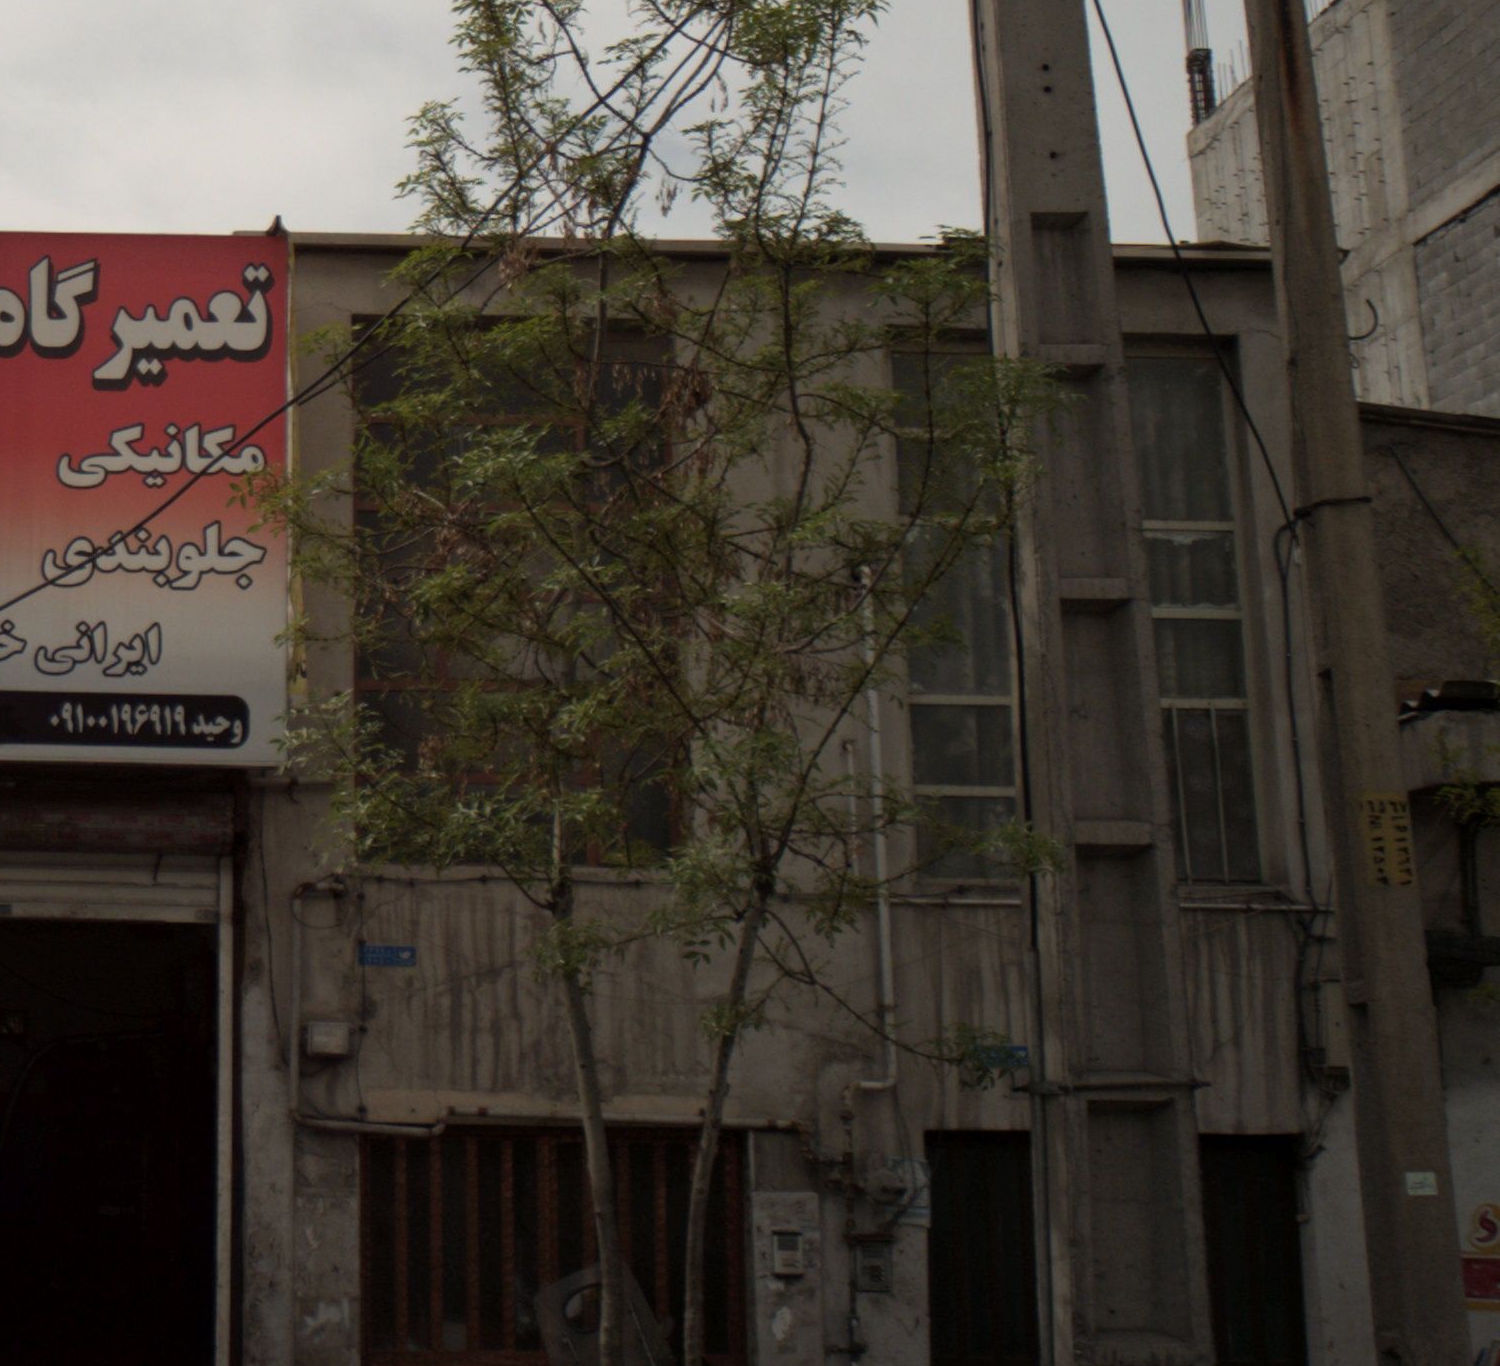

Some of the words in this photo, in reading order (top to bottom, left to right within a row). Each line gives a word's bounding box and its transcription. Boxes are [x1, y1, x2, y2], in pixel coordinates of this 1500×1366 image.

[57, 424, 267, 487] مکانیکی
[42, 522, 266, 590] جلوبندی
[35, 622, 162, 676] ایرانی
[50, 702, 186, 735] ۰۹۱۰۰۱۹۶۹۱۹
[192, 714, 243, 743] وحید
